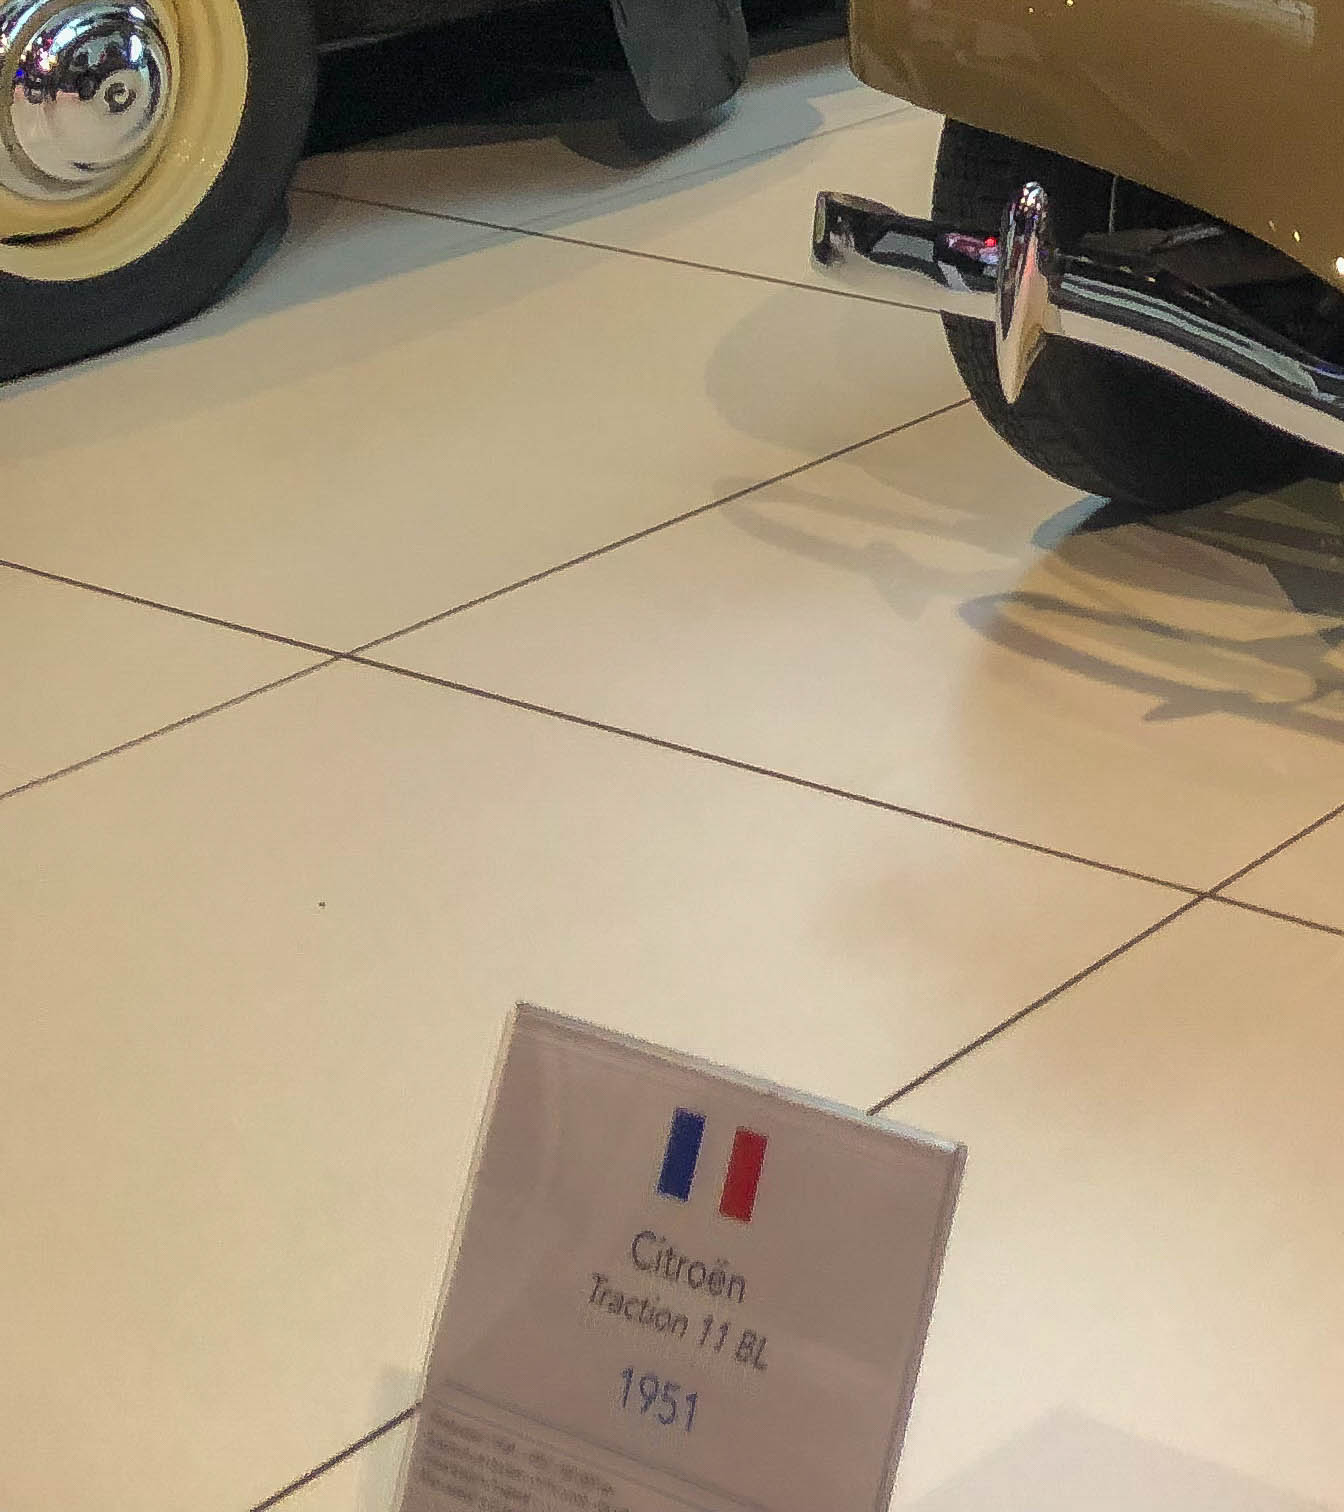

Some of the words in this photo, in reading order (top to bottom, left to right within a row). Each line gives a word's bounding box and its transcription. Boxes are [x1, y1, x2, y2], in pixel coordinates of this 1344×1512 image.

[630, 1230, 746, 1304] Citroën
[588, 1272, 689, 1338] Traction
[698, 1314, 729, 1353] 11
[733, 1328, 769, 1371] BL
[620, 1367, 698, 1432] 1951
